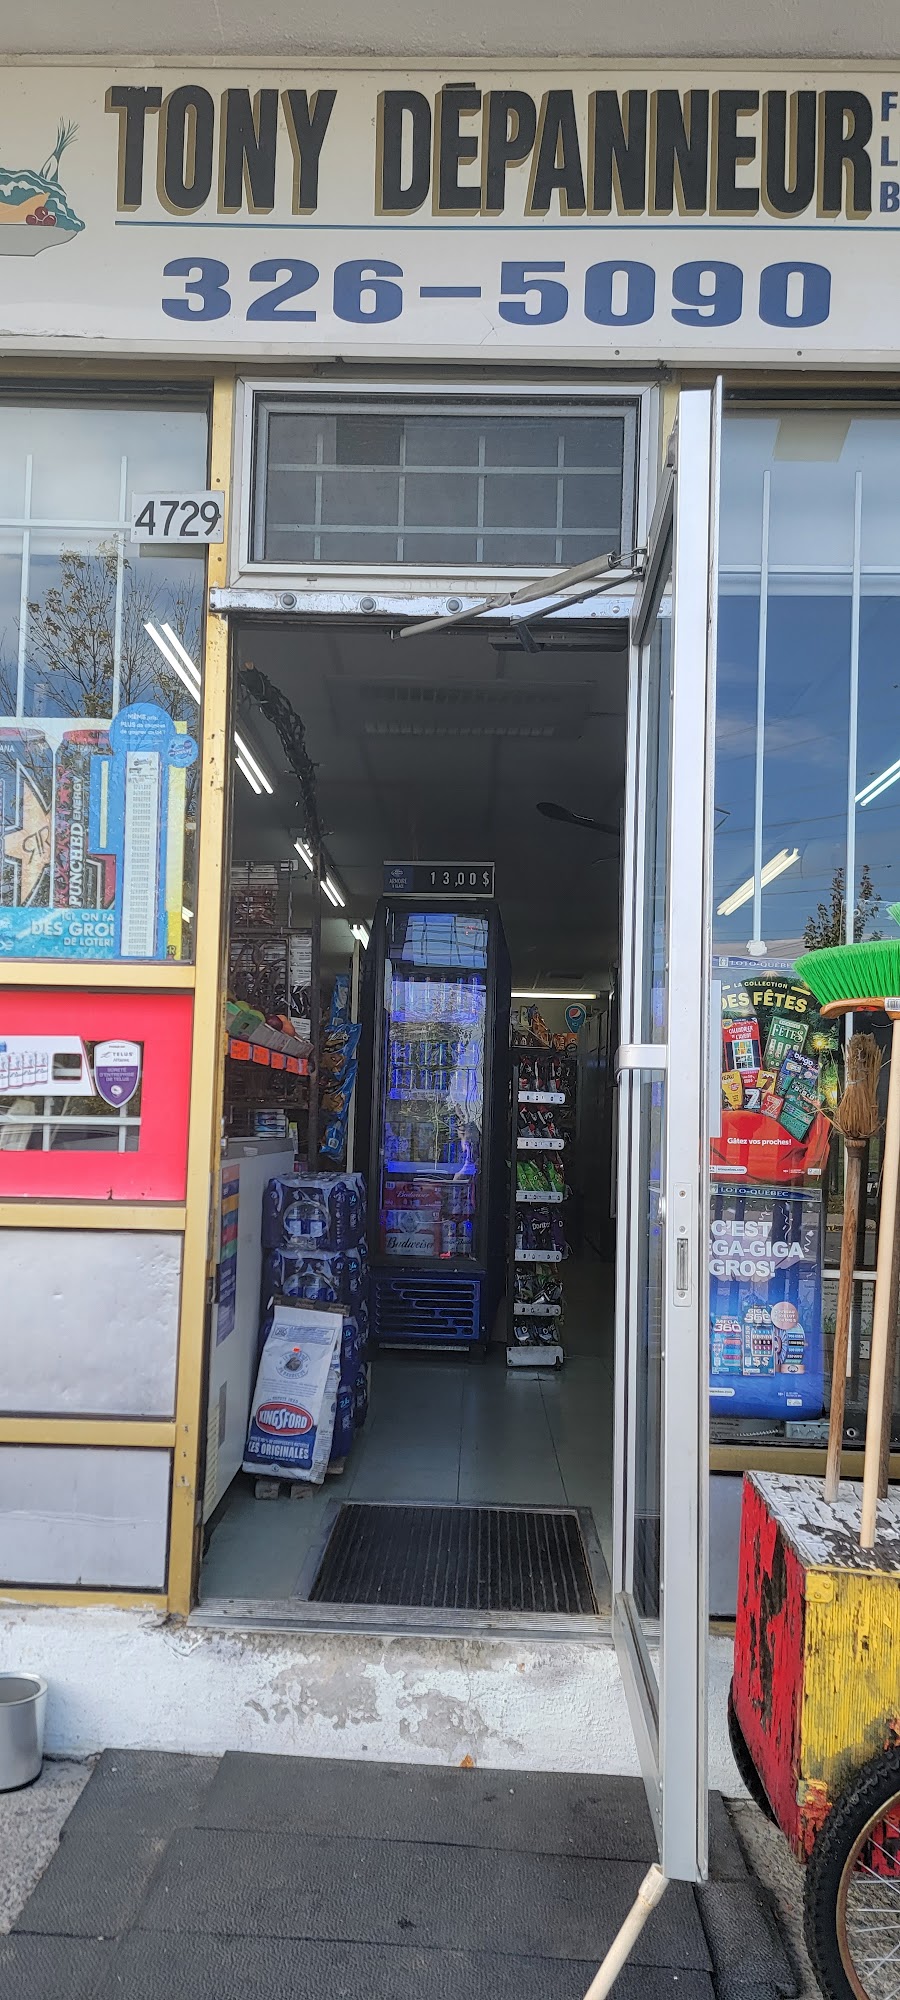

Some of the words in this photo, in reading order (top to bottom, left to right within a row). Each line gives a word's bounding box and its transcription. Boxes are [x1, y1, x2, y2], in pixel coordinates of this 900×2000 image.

[105, 85, 336, 216] TONY
[375, 82, 874, 220] DÉPANNEUR
[161, 256, 832, 328] 326-5090
[134, 500, 219, 537] 4729
[73, 776, 84, 822] ENERGY
[69, 822, 84, 908] PUNCHED
[82, 912, 99, 922] ON
[30, 920, 63, 937] DES
[63, 938, 77, 947] DE
[730, 960, 792, 969] LOTO-QUÉBE
[744, 980, 788, 989] COLLECTION
[753, 989, 808, 1013] FÊTES
[770, 1023, 804, 1042] FÊTES
[793, 1052, 814, 1066] bingo
[727, 1137, 747, 1145] Gâtez
[762, 1139, 792, 1147] proches!
[711, 1220, 773, 1238] C'EST
[387, 1236, 433, 1249] Budweiser
[708, 1240, 805, 1258] GA-GIGA
[708, 1259, 776, 1278] GROS!
[714, 1323, 742, 1333] 360
[258, 1408, 308, 1430] KINGSFORD
[247, 1441, 260, 1454] LES
[260, 1442, 310, 1460] ORIGINALES
